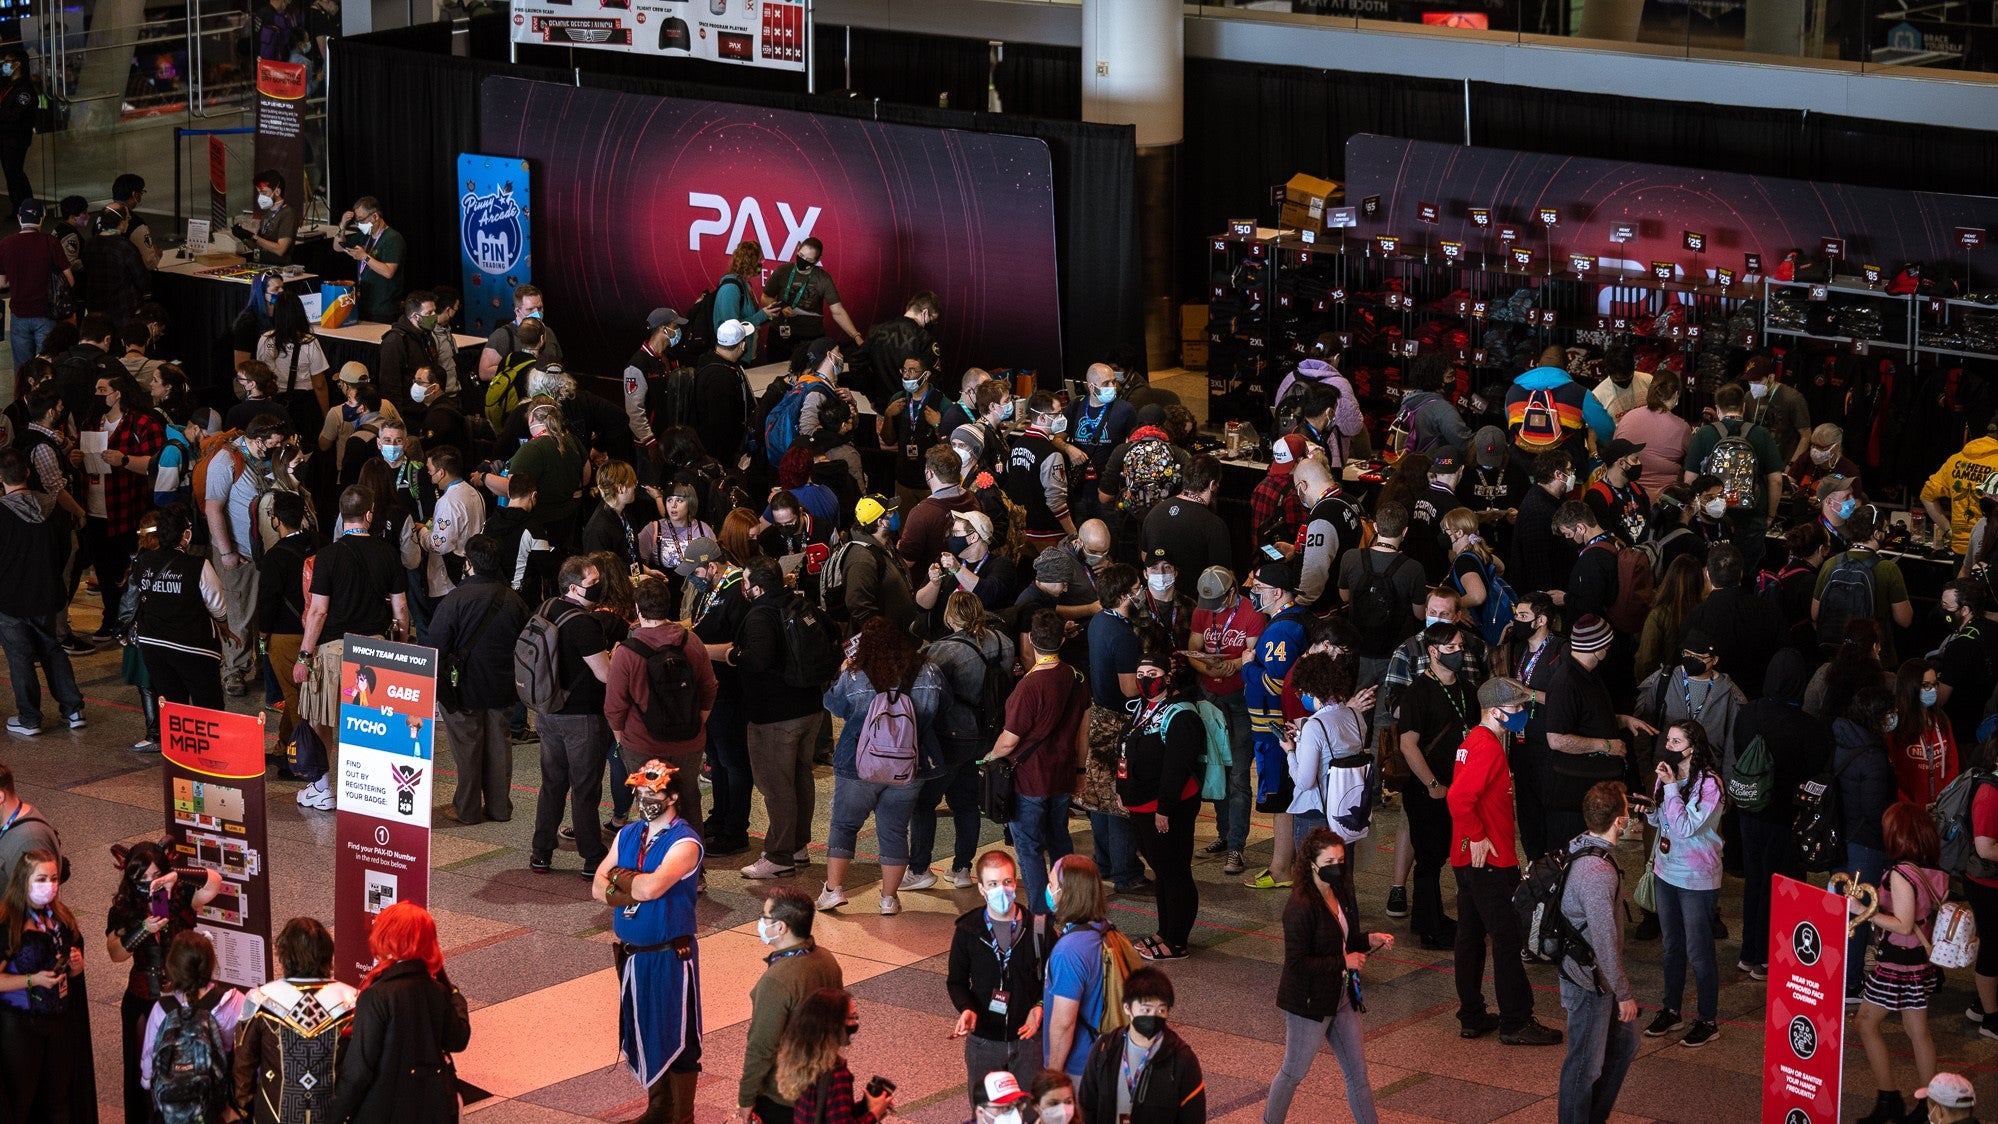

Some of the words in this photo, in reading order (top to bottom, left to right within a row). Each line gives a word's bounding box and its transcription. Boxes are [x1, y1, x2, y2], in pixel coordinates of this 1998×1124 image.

[464, 196, 494, 214] Pinny
[479, 202, 517, 227] Arcade
[1474, 215, 1488, 224] $65
[1541, 213, 1556, 223] $65
[689, 192, 823, 266] PAX
[1234, 226, 1250, 234] $50
[1215, 242, 1224, 250] XS
[1381, 240, 1394, 250] $25
[1688, 238, 1701, 248] $25
[482, 243, 505, 262] PIN
[1443, 246, 1458, 256] $25
[1516, 254, 1529, 263] $25
[1574, 260, 1590, 270] $25
[1656, 268, 1670, 278] $25
[1866, 271, 1878, 281] $85
[1719, 274, 1730, 285] $25
[1216, 288, 1221, 296] M
[1332, 290, 1343, 299] XS
[1812, 288, 1824, 297] XS
[1391, 295, 1396, 303] S
[1403, 297, 1412, 306] XS
[1319, 301, 1323, 309] L
[1474, 303, 1484, 311] XS
[1932, 302, 1939, 311] M
[1530, 310, 1534, 320] S
[1544, 313, 1553, 322] XS
[1599, 320, 1604, 328] S
[1615, 320, 1625, 328] XS
[1673, 327, 1678, 335] S
[1688, 327, 1698, 336] XS
[876, 330, 914, 351] PAX
[1212, 334, 1221, 342] XL
[1250, 338, 1264, 347] 2XL
[1340, 336, 1347, 344] M
[1747, 336, 1752, 344] S
[1295, 343, 1305, 352] XL
[1405, 344, 1412, 352] M
[1476, 353, 1482, 361] M
[1210, 380, 1223, 388] 3XL
[1688, 377, 1694, 385] M
[1250, 384, 1263, 392] 4XL
[1386, 387, 1400, 397] 2XL
[1472, 398, 1482, 410] XL
[1952, 470, 1987, 483] CAMBRI
[1307, 534, 1324, 547] 20
[142, 579, 150, 590] SO
[152, 580, 181, 593] BELOW
[352, 646, 374, 656] WHICH
[376, 650, 394, 659] TEAM
[409, 658, 427, 666] YOU?
[1265, 641, 1286, 662] 24
[387, 685, 420, 702] GABE
[380, 705, 393, 716] VS
[169, 715, 220, 739] BCEC
[347, 717, 386, 736] TYCHO
[170, 734, 209, 754] MAP
[346, 760, 361, 768] FIND
[346, 770, 359, 778] OUT
[361, 773, 369, 781] BY
[346, 781, 386, 794] REGISTERING
[346, 791, 363, 800] YOUR
[364, 796, 388, 805] BADGE:
[379, 830, 384, 841] 1
[348, 842, 360, 850] Find
[374, 847, 393, 857] PAX-ID
[394, 851, 416, 862] Number
[371, 856, 380, 864] red
[380, 858, 390, 866] box
[391, 860, 408, 870] below.
[1792, 974, 1805, 984] WEAR
[1806, 978, 1820, 990] YOUR
[1786, 981, 1811, 995] APPROVED
[1812, 990, 1824, 1000] FACE
[1792, 991, 1817, 1006] COVERING
[1780, 1064, 1794, 1076] WASH
[1795, 1070, 1802, 1078] OR
[1802, 1072, 1823, 1086] SANITIZE
[1786, 1075, 1799, 1085] YOUR
[1800, 1079, 1816, 1092] HANDS
[1786, 1084, 1815, 1100] FREQUENTLY
